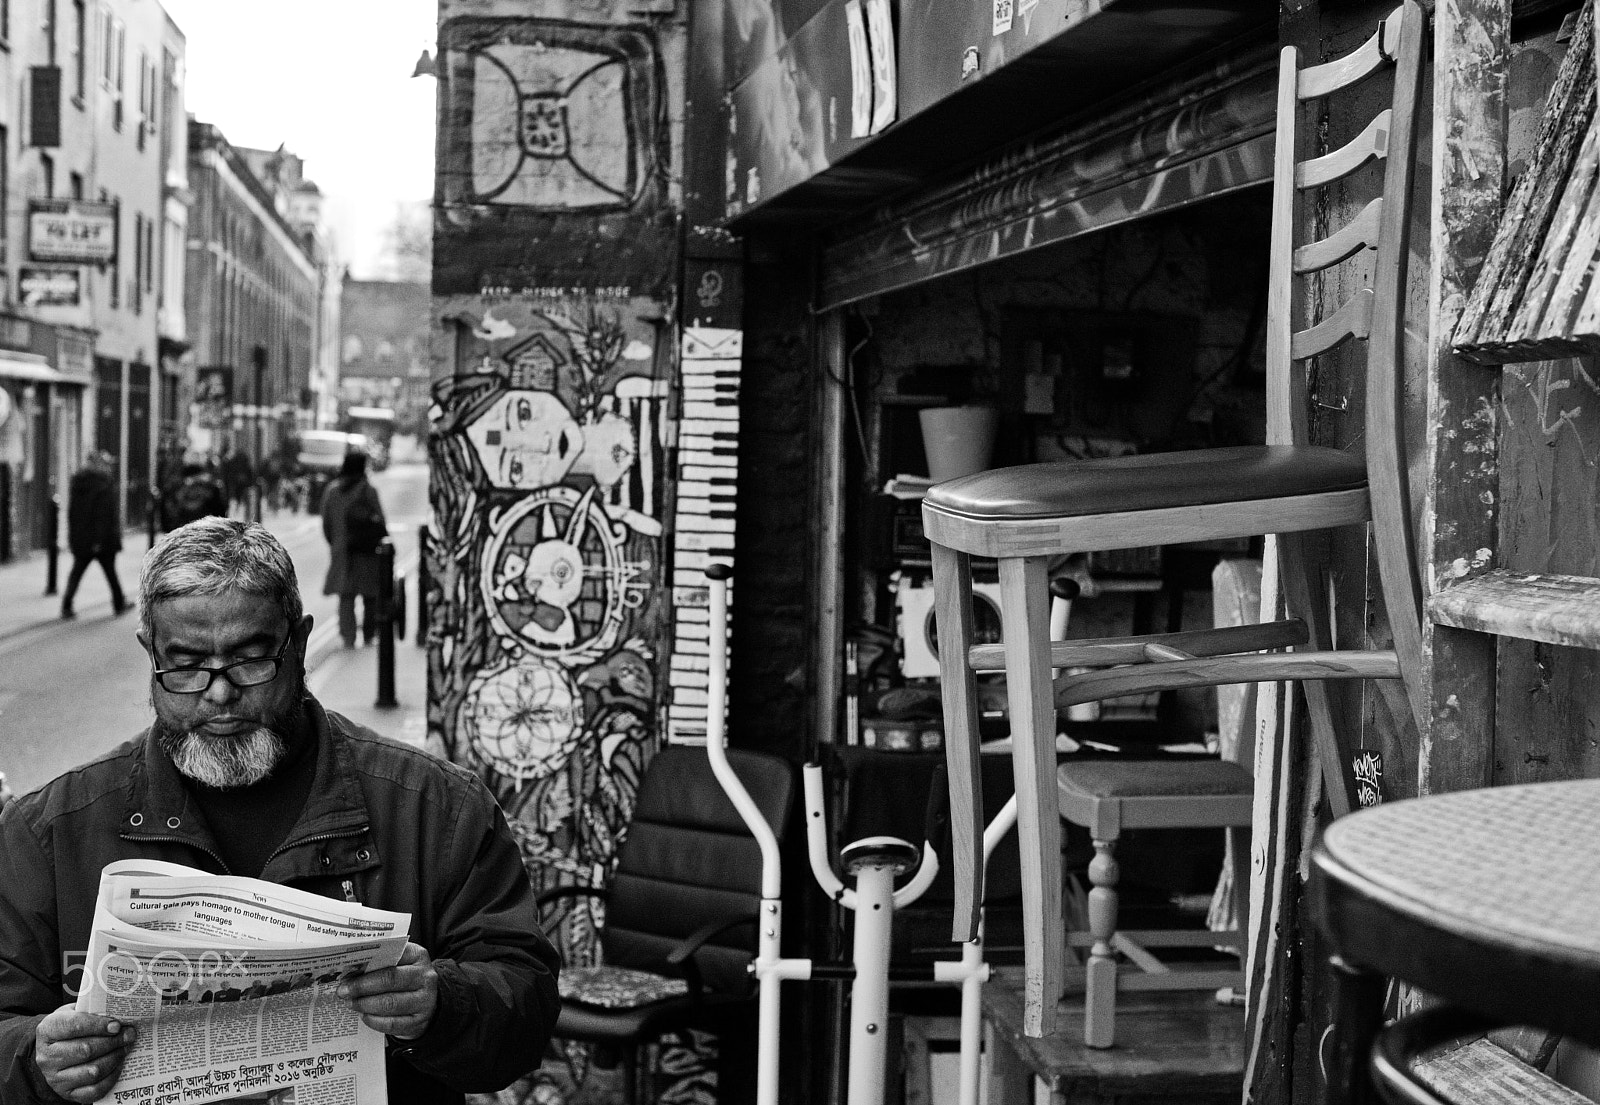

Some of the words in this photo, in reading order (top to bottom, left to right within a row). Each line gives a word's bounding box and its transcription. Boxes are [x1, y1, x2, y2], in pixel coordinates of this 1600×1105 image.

[253, 893, 267, 903] News
[130, 902, 161, 910] Cultural
[163, 902, 179, 911] gala
[181, 900, 200, 908] pays
[202, 900, 232, 913] homage
[234, 906, 242, 915] to
[243, 910, 269, 924] mother
[270, 917, 296, 929] tongue
[194, 911, 233, 926] languages
[307, 923, 321, 933] Road
[322, 927, 338, 937] safety
[339, 930, 356, 938] magic
[114, 1084, 155, 1104] যুক্তরাজ্যে
[157, 1075, 184, 1094] প্রবাসী
[186, 1070, 211, 1087] আদর্শ
[277, 1062, 285, 1071] ও
[287, 1056, 315, 1069] কলেজ
[317, 1050, 358, 1065] দৌলতপুর
[183, 1081, 230, 1102] শিক্ষার্থীদের
[274, 1071, 300, 1084] ২০১৬
[302, 1062, 334, 1080] অনুষ্ঠিত
